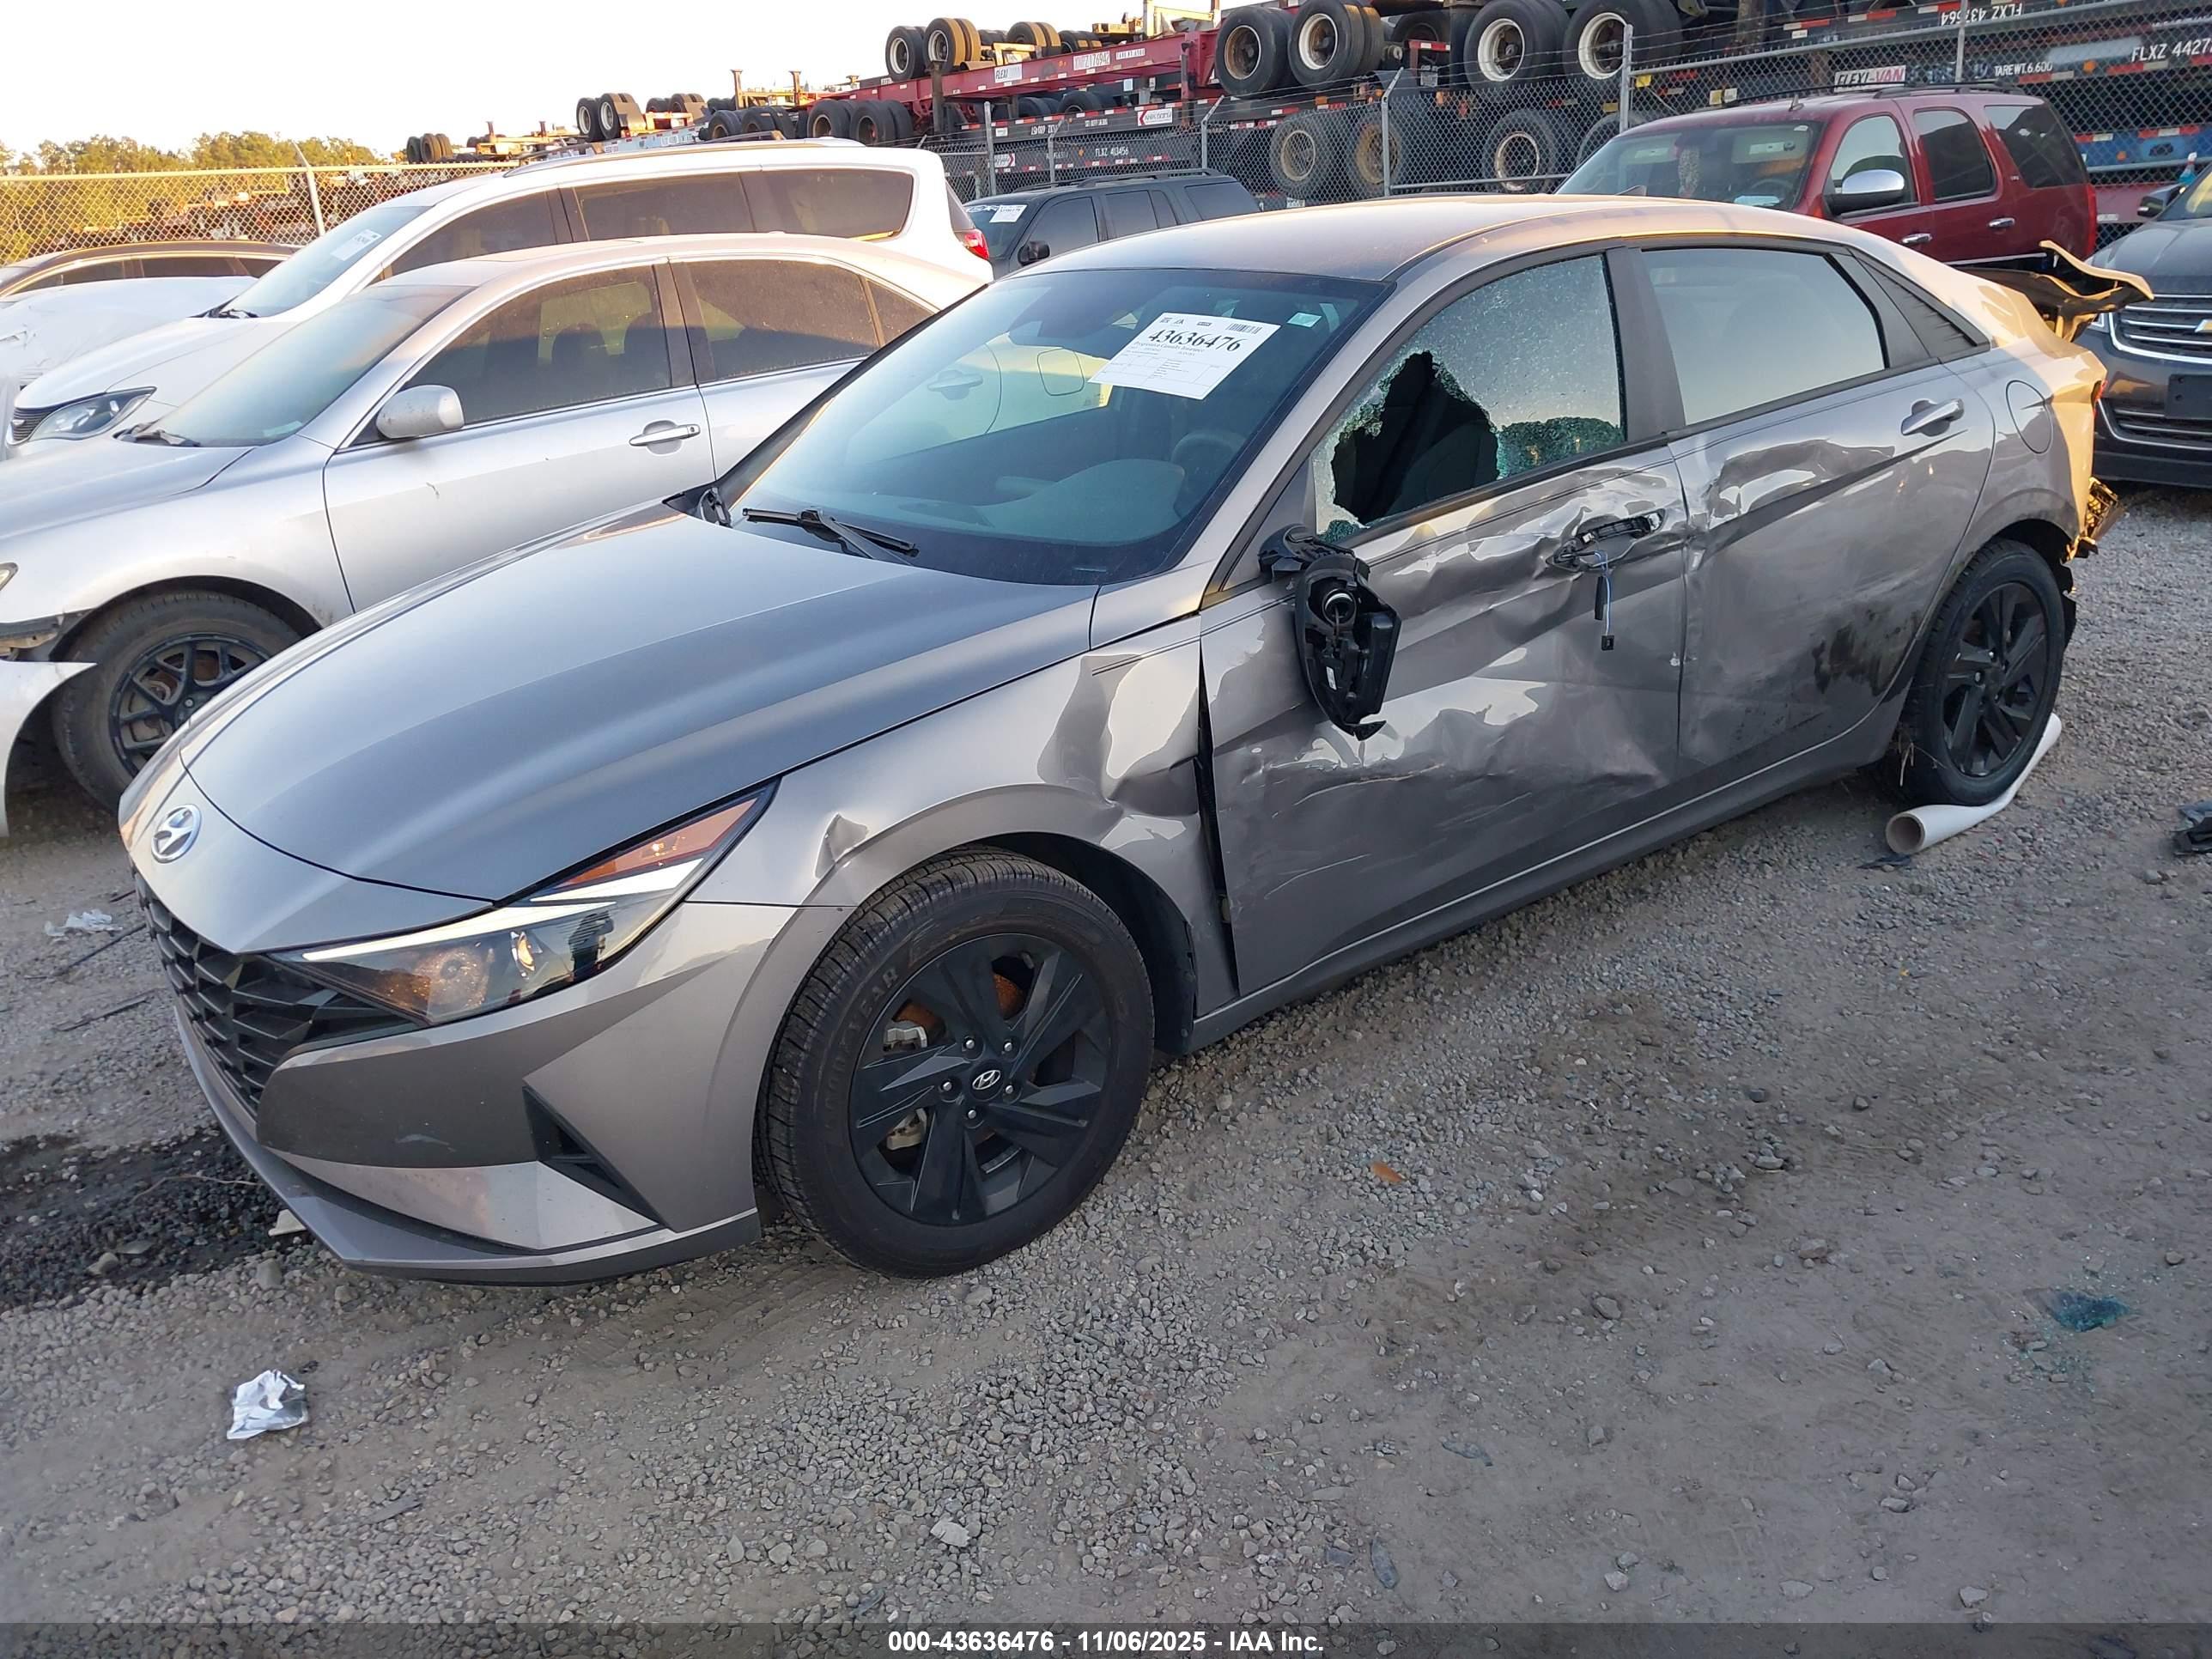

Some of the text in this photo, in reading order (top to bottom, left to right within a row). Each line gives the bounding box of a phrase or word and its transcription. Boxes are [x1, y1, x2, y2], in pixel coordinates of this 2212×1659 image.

[2130, 37, 2212, 63] FLXZ 4427
[1836, 68, 1905, 88] FLEXI-VAN
[1149, 329, 1247, 352] 43636476
